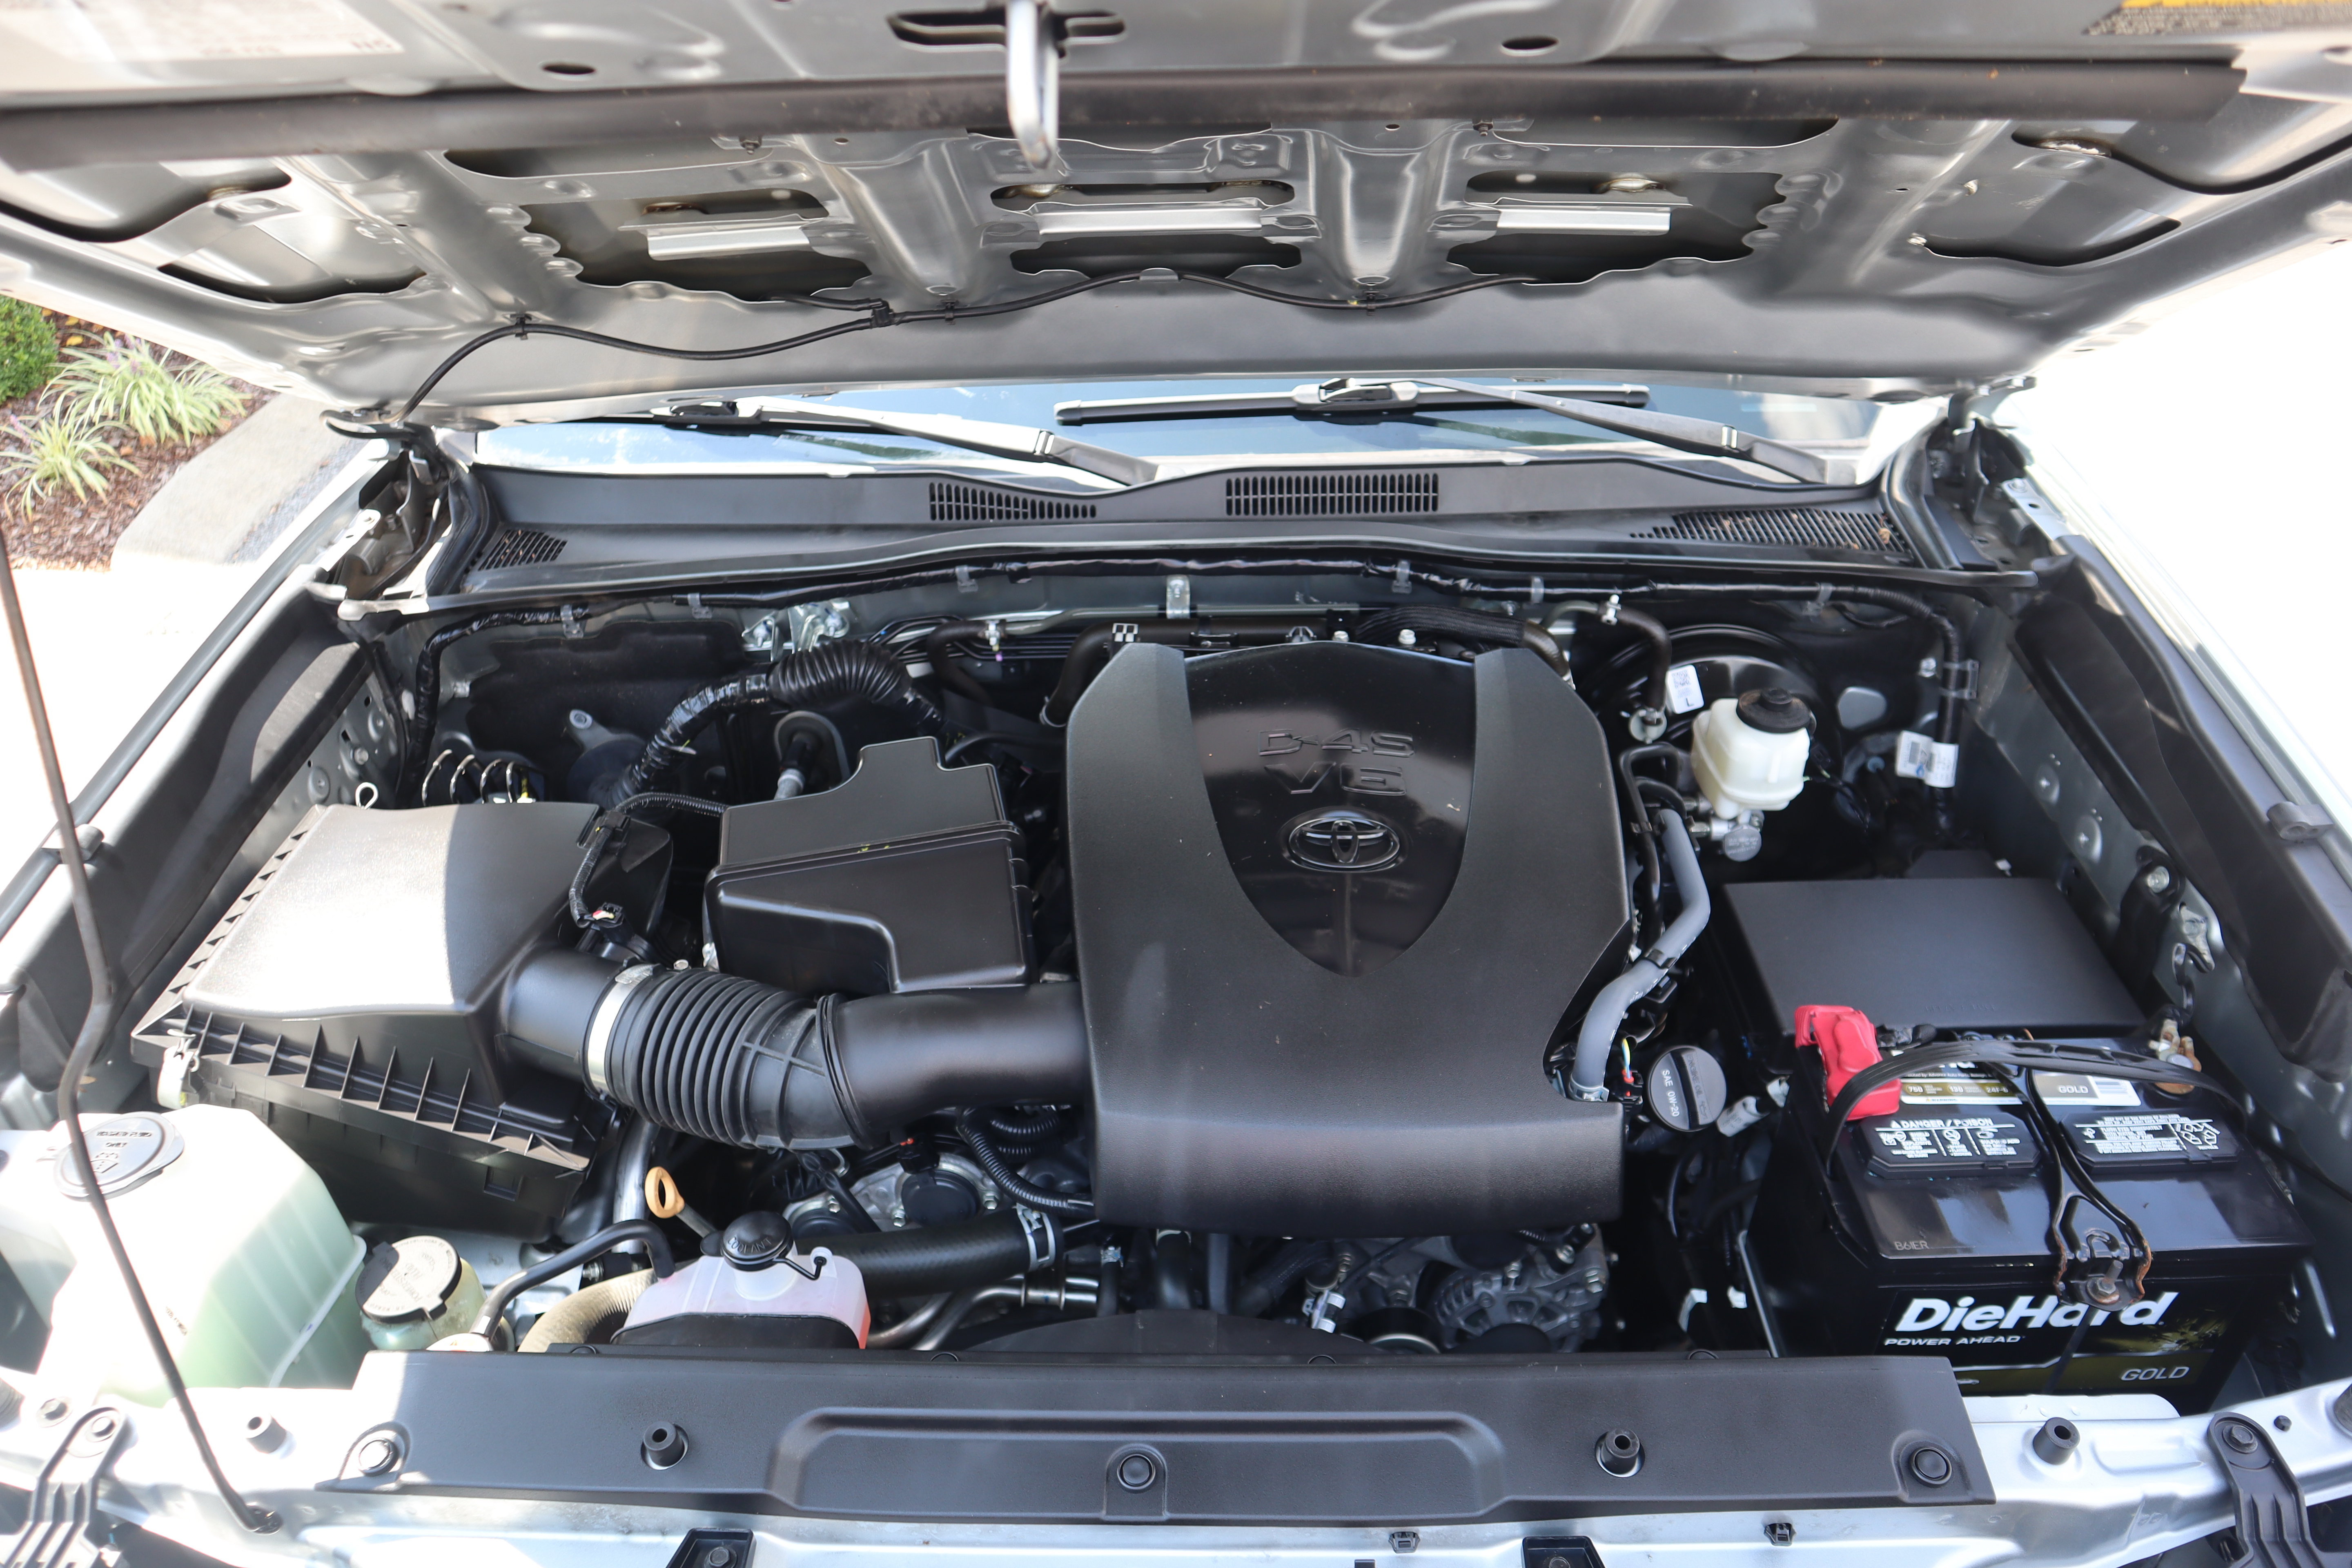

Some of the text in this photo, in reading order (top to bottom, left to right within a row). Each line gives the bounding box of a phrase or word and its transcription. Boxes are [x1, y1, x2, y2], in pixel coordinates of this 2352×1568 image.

[1264, 761, 1407, 796] V6
[1663, 1069, 1680, 1117] SAE 0W-20
[2058, 1085, 2089, 1094] GOLD
[1900, 1119, 1945, 1128] DANGER
[1953, 1118, 1994, 1127] POISON
[1895, 1292, 2179, 1332] DieHard
[1884, 1335, 2021, 1346] POWER AHEAD
[2121, 1366, 2190, 1381] GOLD
